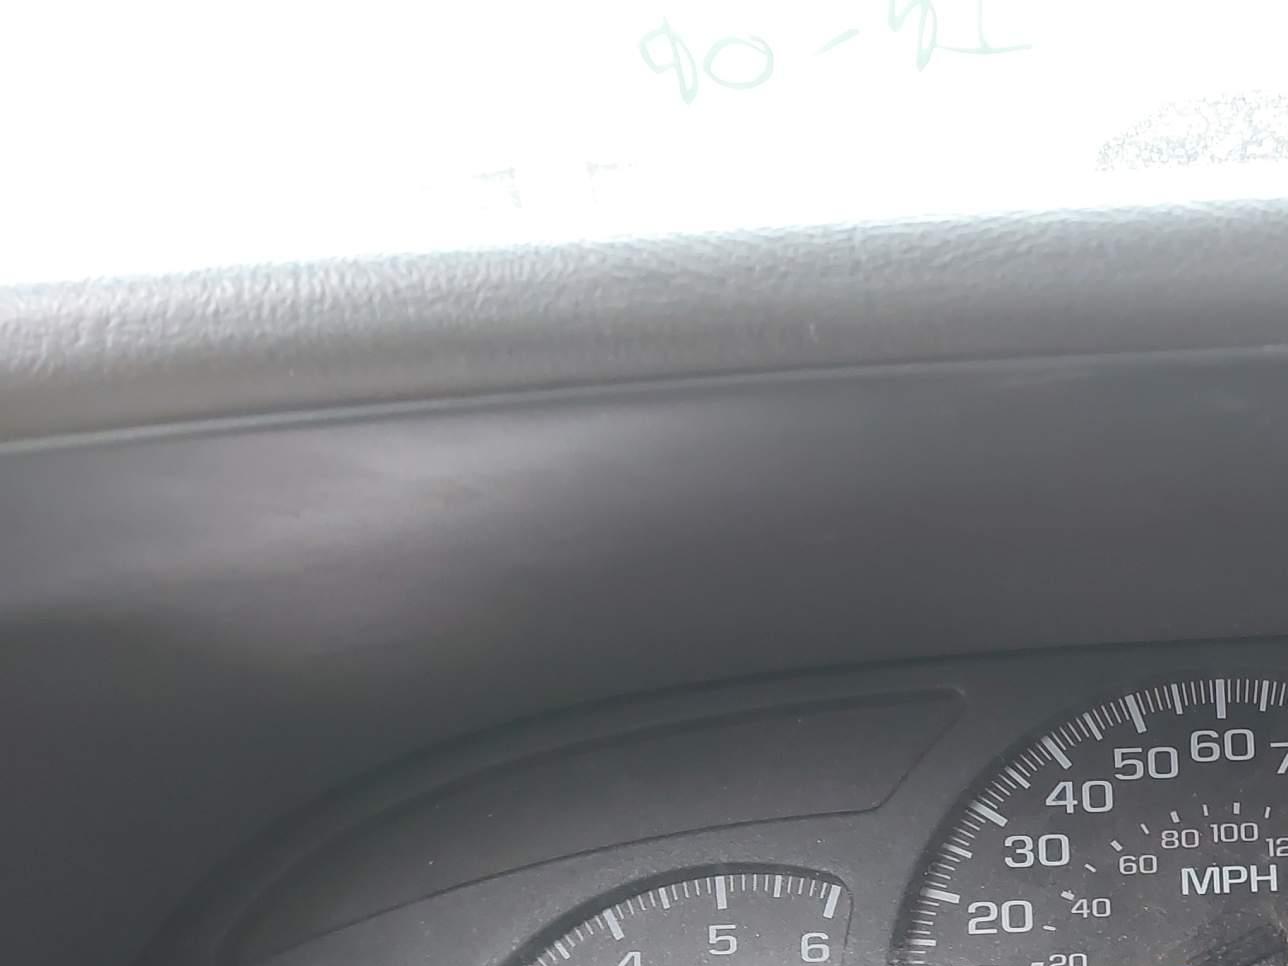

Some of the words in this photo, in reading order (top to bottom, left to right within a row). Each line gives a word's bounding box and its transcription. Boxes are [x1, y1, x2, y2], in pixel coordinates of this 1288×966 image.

[1191, 729, 1254, 761] 60
[1115, 747, 1178, 779] 50
[1046, 781, 1112, 813] 40
[1162, 830, 1199, 848] 80
[1211, 823, 1258, 842] 100
[1005, 835, 1069, 867] 30
[1120, 855, 1157, 874] 60
[1182, 865, 1277, 894] MPH
[968, 901, 1032, 934] 20
[1070, 897, 1113, 919] 40
[709, 925, 736, 954] 5
[802, 933, 829, 962] 6
